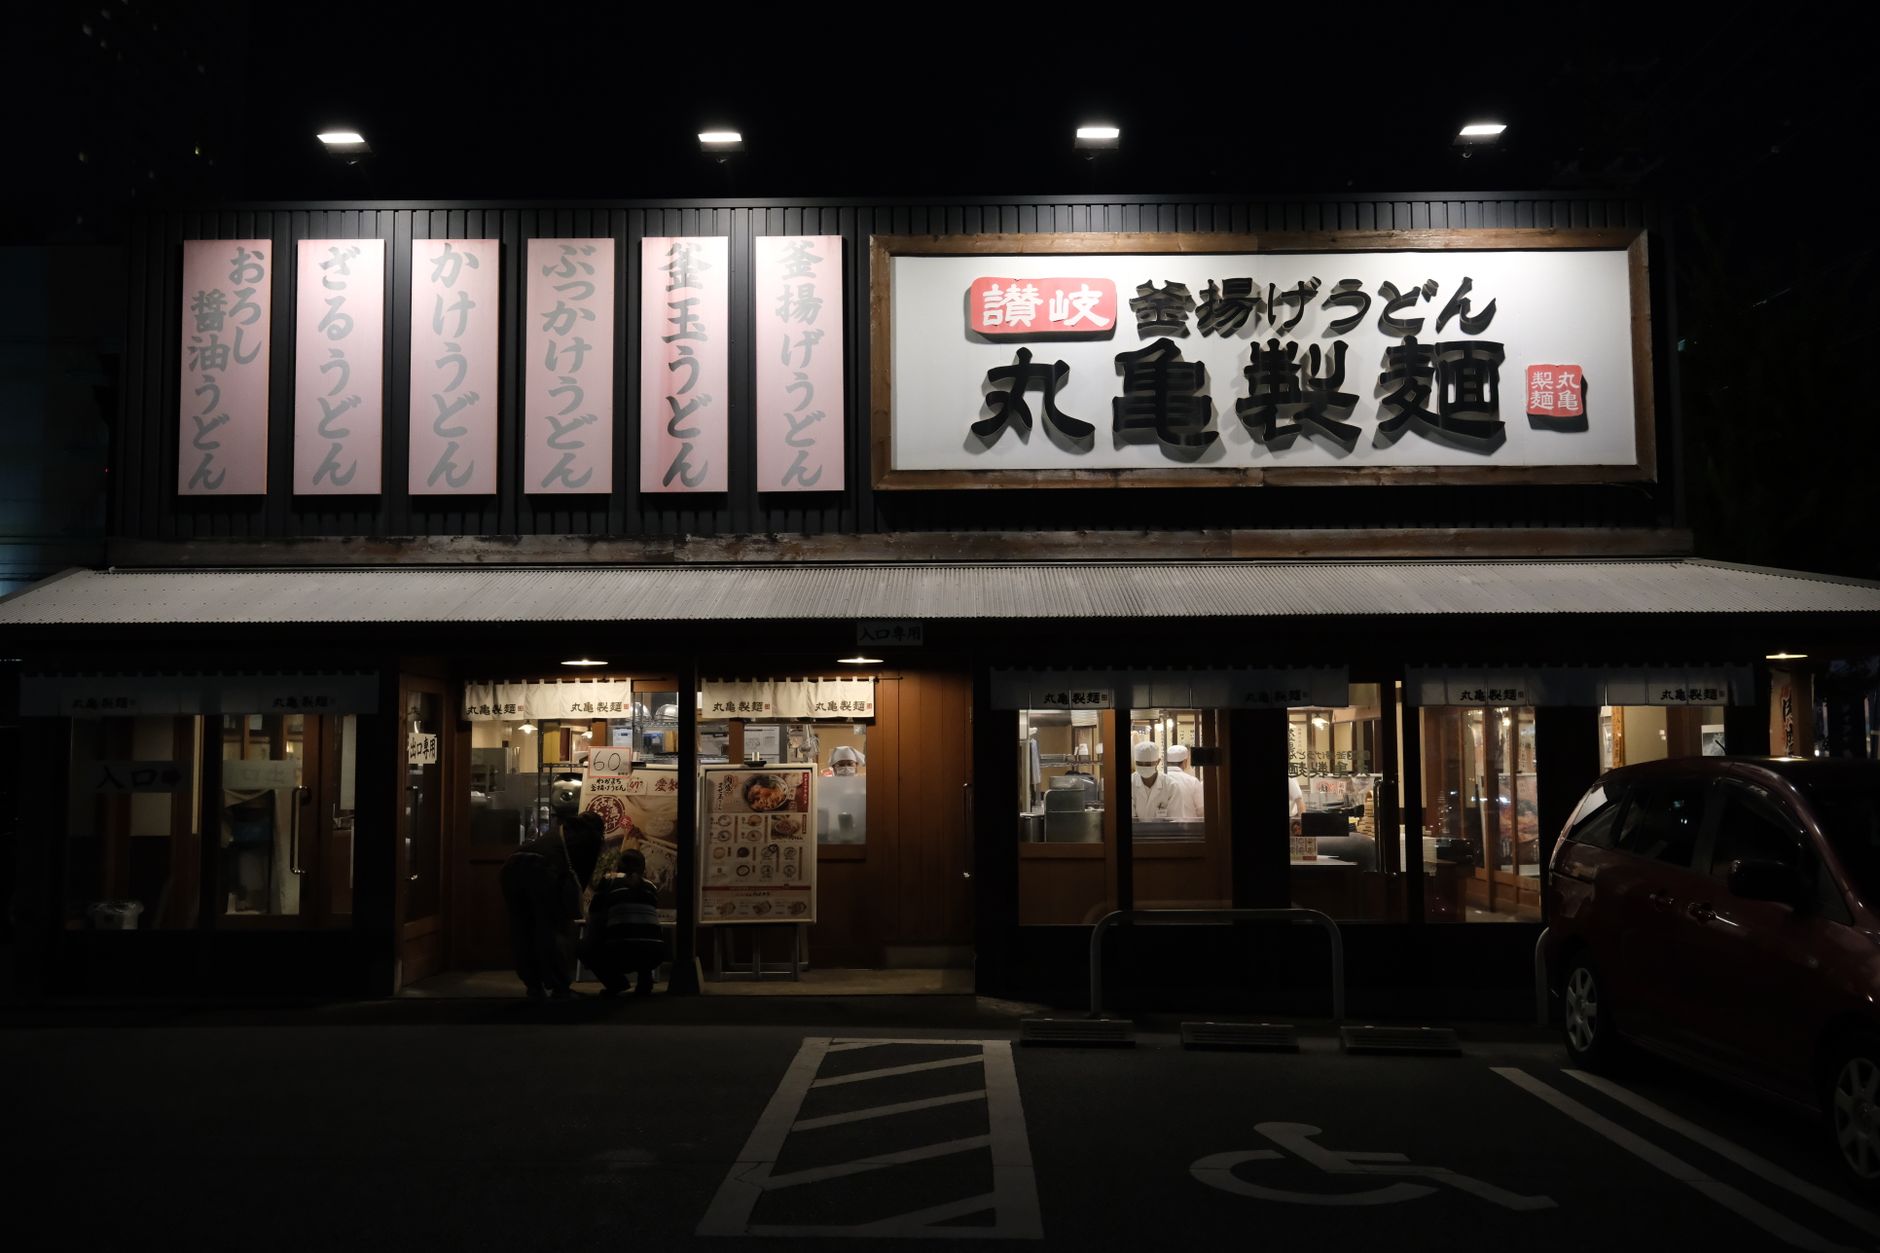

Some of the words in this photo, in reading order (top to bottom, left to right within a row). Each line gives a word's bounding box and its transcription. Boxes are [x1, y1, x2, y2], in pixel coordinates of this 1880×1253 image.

[228, 246, 265, 365] おろし
[1129, 276, 1498, 338] 釜揚げうどん
[312, 245, 362, 487] ざるうどん
[426, 242, 480, 489] かけうどん
[540, 244, 598, 489] ぶっかけうどん
[657, 242, 713, 488] 釜玉うどん
[775, 240, 827, 488] 釜揚げうどん
[970, 336, 1507, 452] 丸亀製麺
[858, 626, 922, 642] 入口専用
[814, 700, 866, 713] 丸亀製麺
[1043, 691, 1101, 705] 丸亀製麺
[1460, 689, 1517, 702] 丸亀製麺
[1660, 688, 1718, 702] 丸亀製麺
[466, 703, 517, 716] 丸亀製麺
[570, 701, 622, 713] 丸亀製麺
[712, 701, 764, 713] 丸亀製麺
[410, 737, 436, 760] 出口専用
[593, 750, 621, 771] 60
[97, 765, 157, 790] 入口
